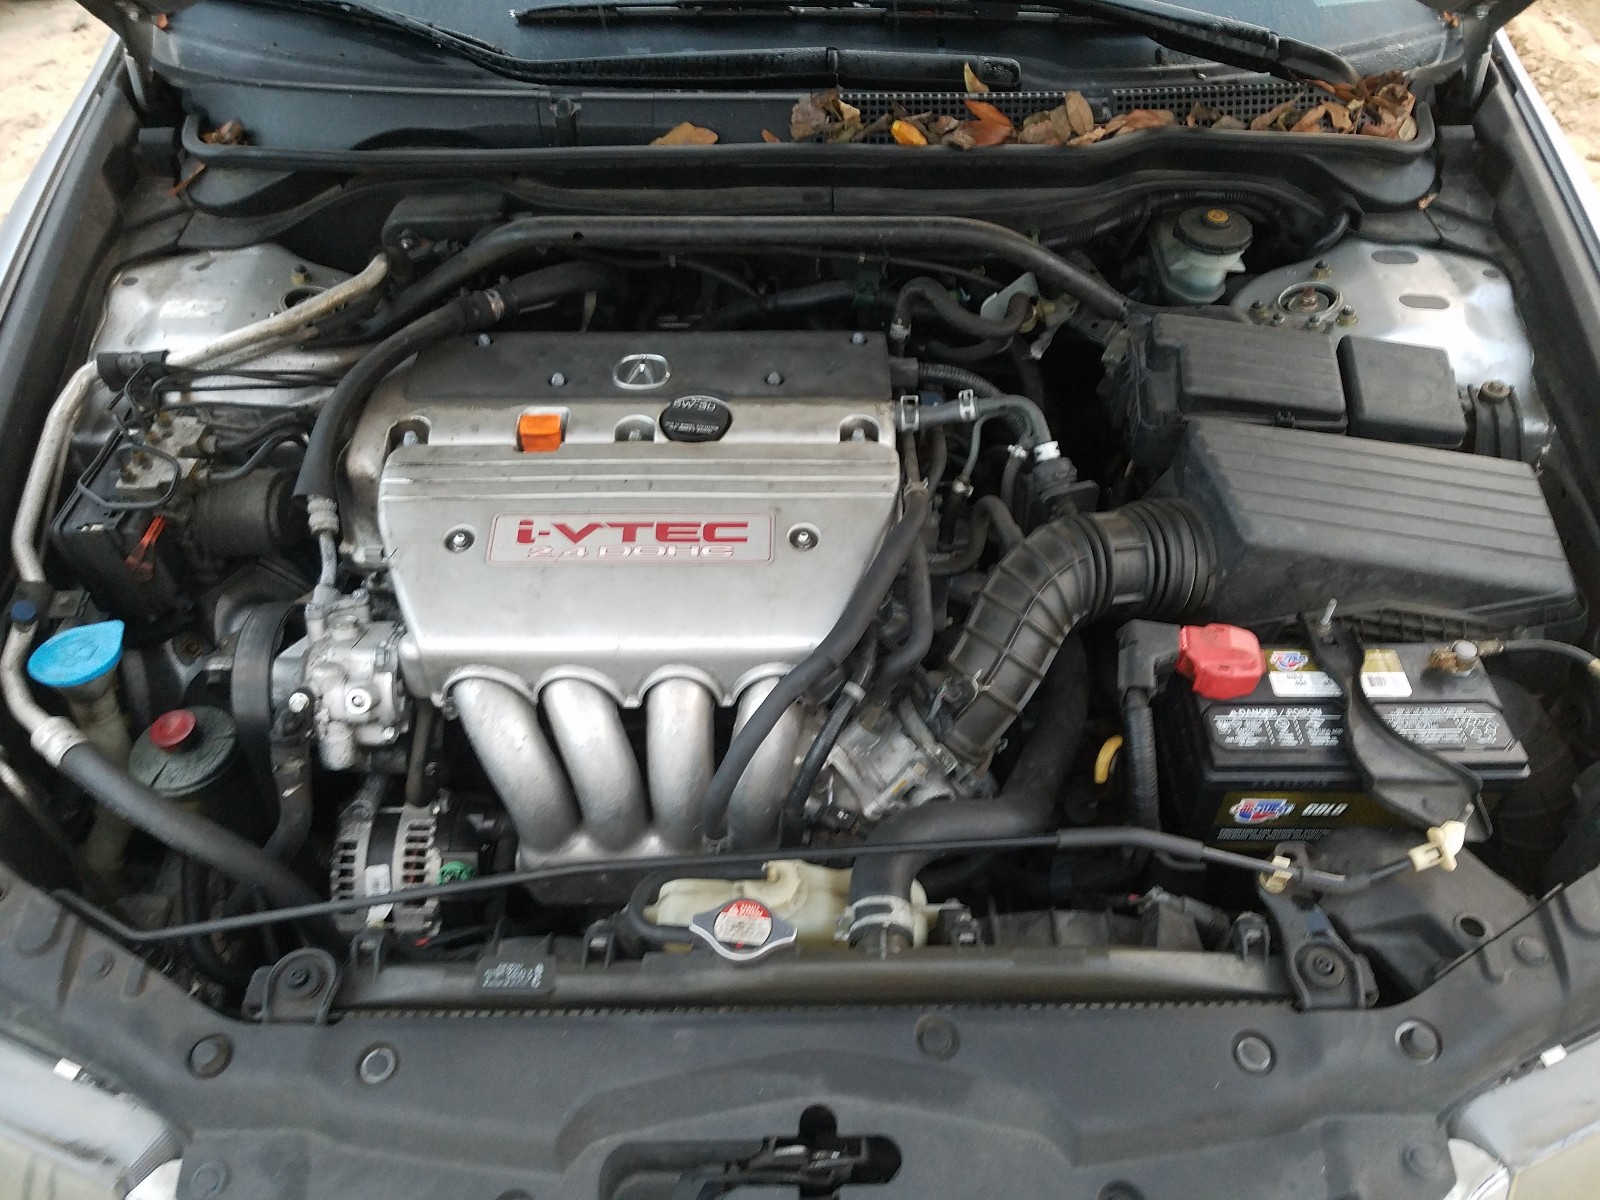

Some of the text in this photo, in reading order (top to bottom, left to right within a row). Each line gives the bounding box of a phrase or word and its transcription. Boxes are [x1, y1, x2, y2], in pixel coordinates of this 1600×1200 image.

[516, 519, 749, 545] i-VTEC
[527, 545, 735, 561] 2.4 DOHC
[1239, 708, 1279, 718] DANGER
